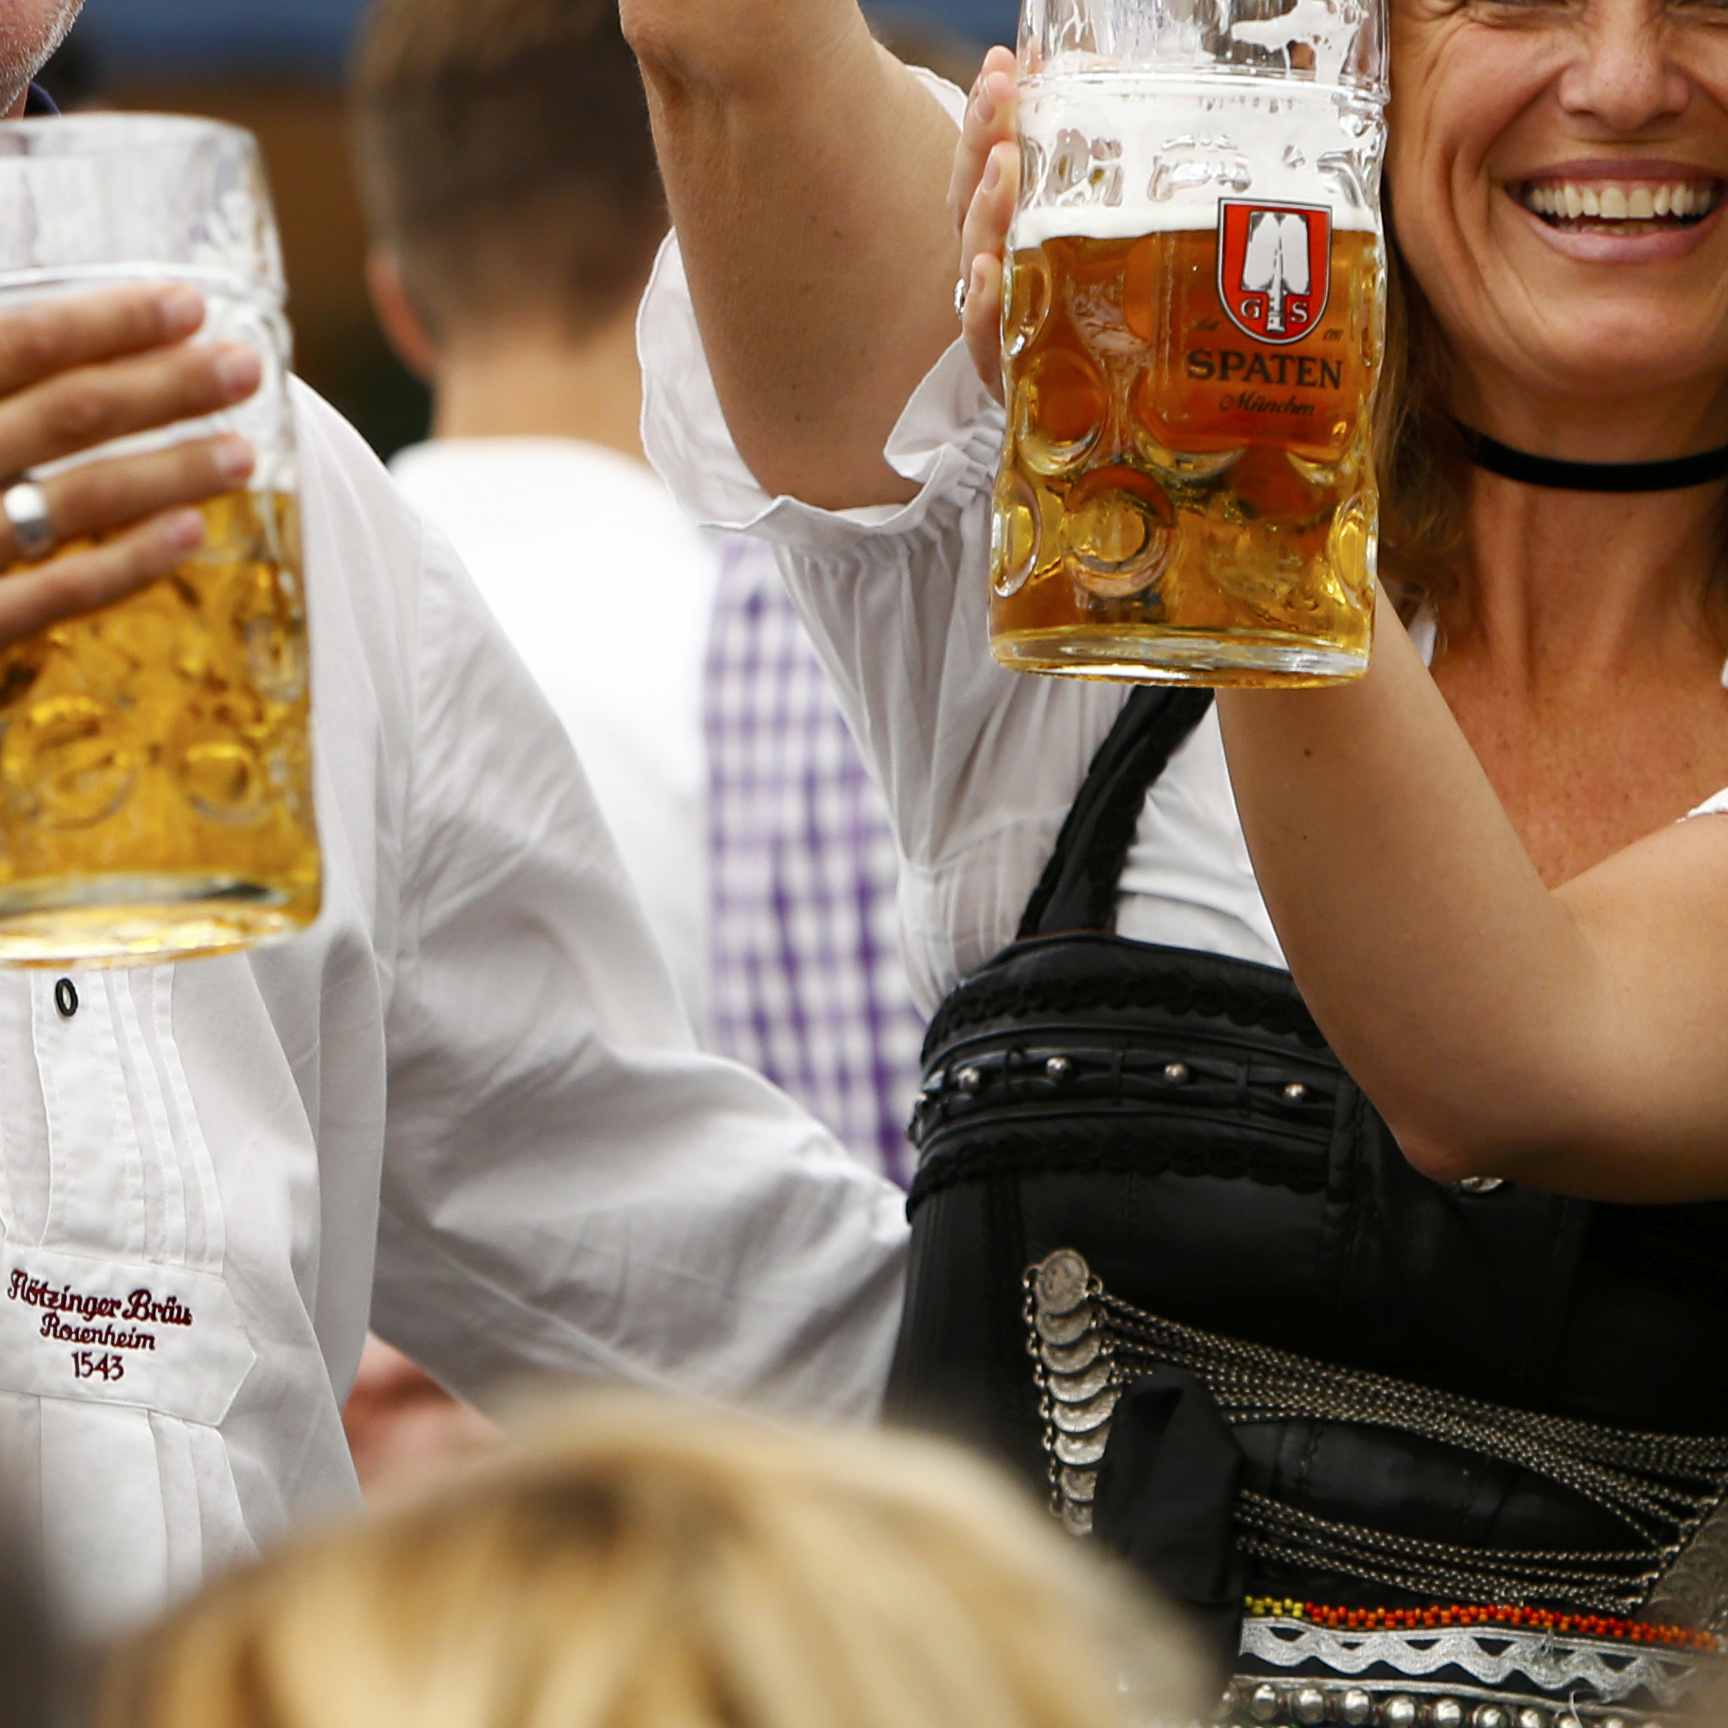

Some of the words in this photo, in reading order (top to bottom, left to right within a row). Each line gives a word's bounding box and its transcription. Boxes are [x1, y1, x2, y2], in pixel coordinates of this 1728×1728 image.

[1240, 298, 1262, 319] G
[1290, 301, 1309, 323] S
[1186, 347, 1344, 391] SPATEN
[121, 1289, 193, 1327] Bräu
[39, 1311, 156, 1351] Rosenheim
[71, 1351, 125, 1381] 1543
